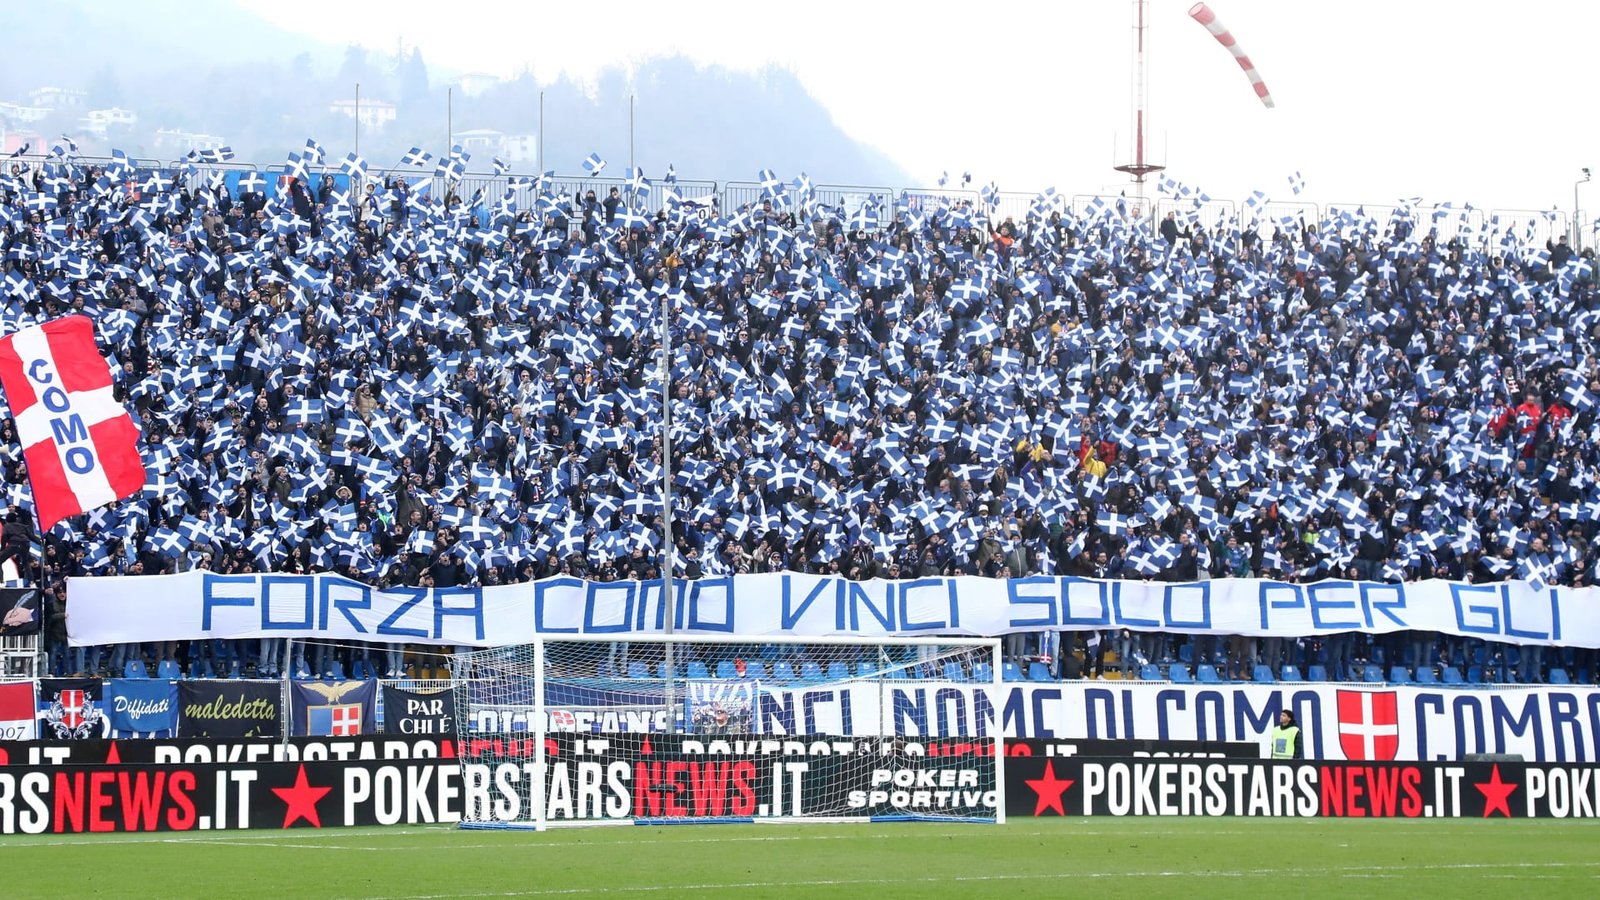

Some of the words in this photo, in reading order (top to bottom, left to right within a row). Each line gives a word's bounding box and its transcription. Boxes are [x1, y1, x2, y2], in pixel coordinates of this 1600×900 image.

[28, 358, 95, 475] COMO
[201, 574, 486, 640] FORZA
[534, 577, 735, 634] COMO
[781, 575, 960, 631] VINCI
[1006, 575, 1212, 630] SOLO
[1258, 581, 1410, 628] PER
[1449, 583, 1562, 640] GLI
[113, 695, 170, 720] Diffidati
[185, 694, 276, 721] maledetta
[407, 699, 443, 716] PAR
[399, 718, 434, 734] CHI
[1156, 689, 1325, 760] COMO
[871, 769, 979, 787] POKER
[1083, 762, 1466, 817] POKERSTARSNEWS.IT
